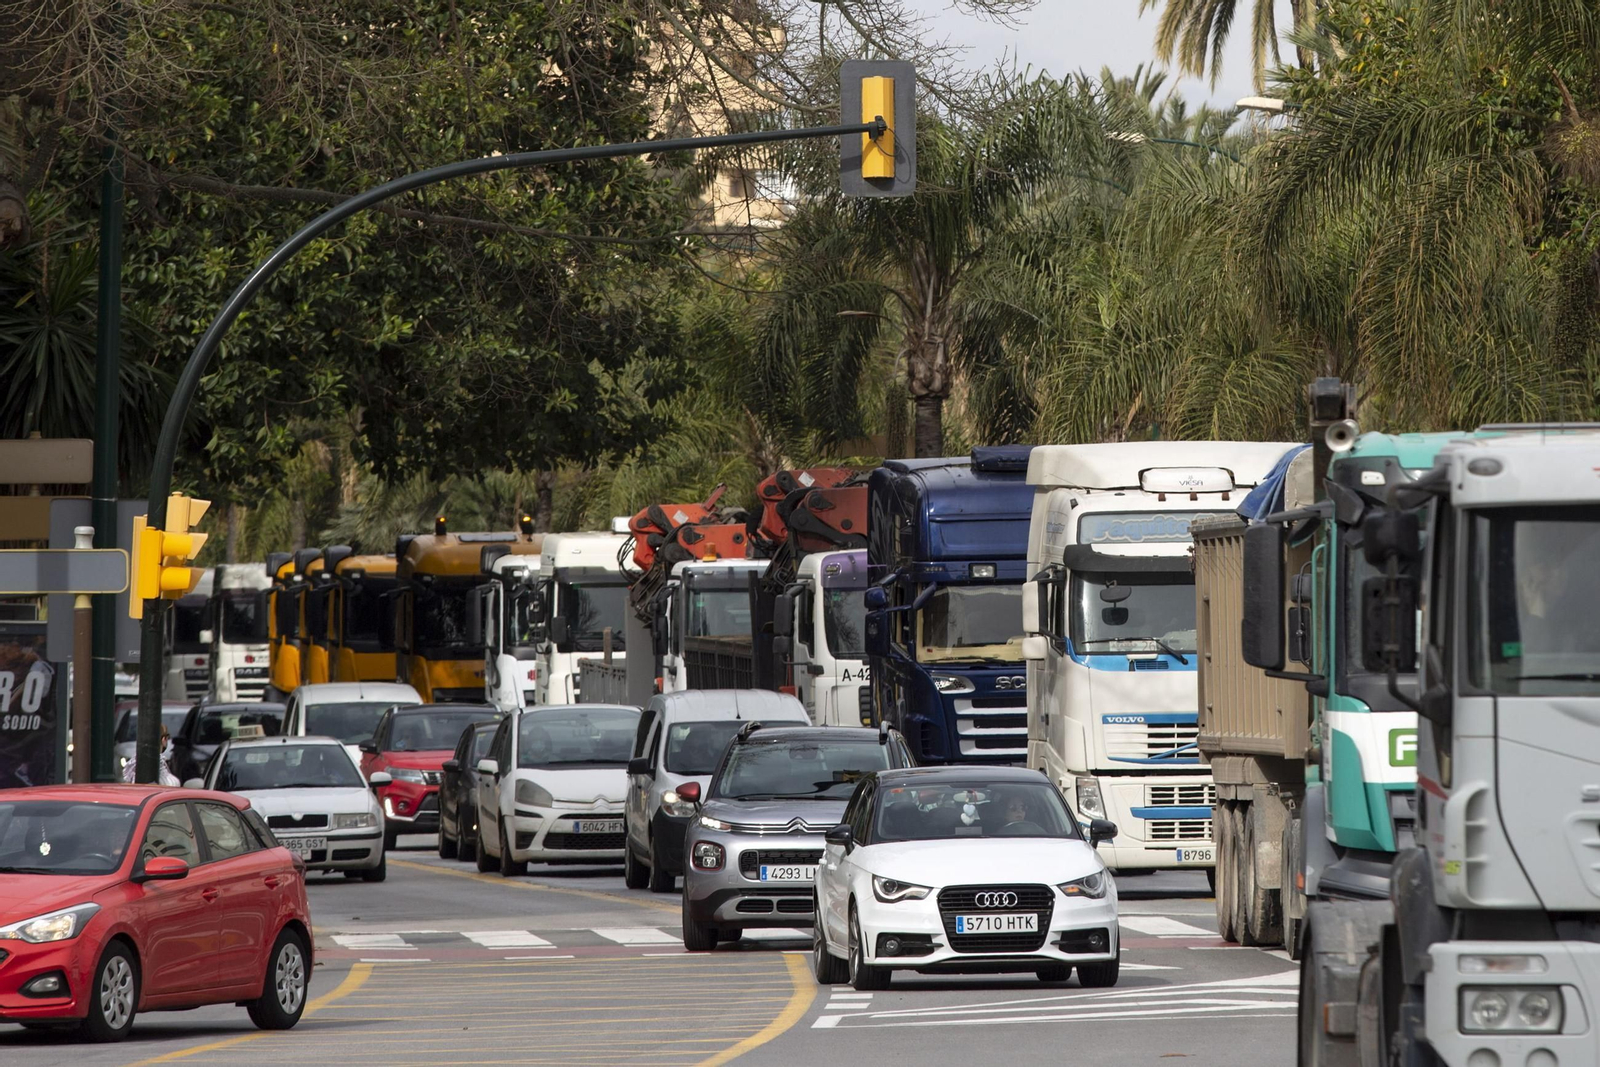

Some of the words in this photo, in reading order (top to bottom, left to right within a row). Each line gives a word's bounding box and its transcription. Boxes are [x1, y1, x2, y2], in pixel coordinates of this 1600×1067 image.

[2, 715, 41, 730] SODIO
[582, 822, 606, 832] 6042
[305, 838, 324, 848] GSY
[1183, 849, 1212, 861] 8796
[770, 867, 801, 880] 4293
[805, 867, 817, 880] L
[966, 916, 1003, 931] 5710
[1006, 916, 1034, 930] HTK
